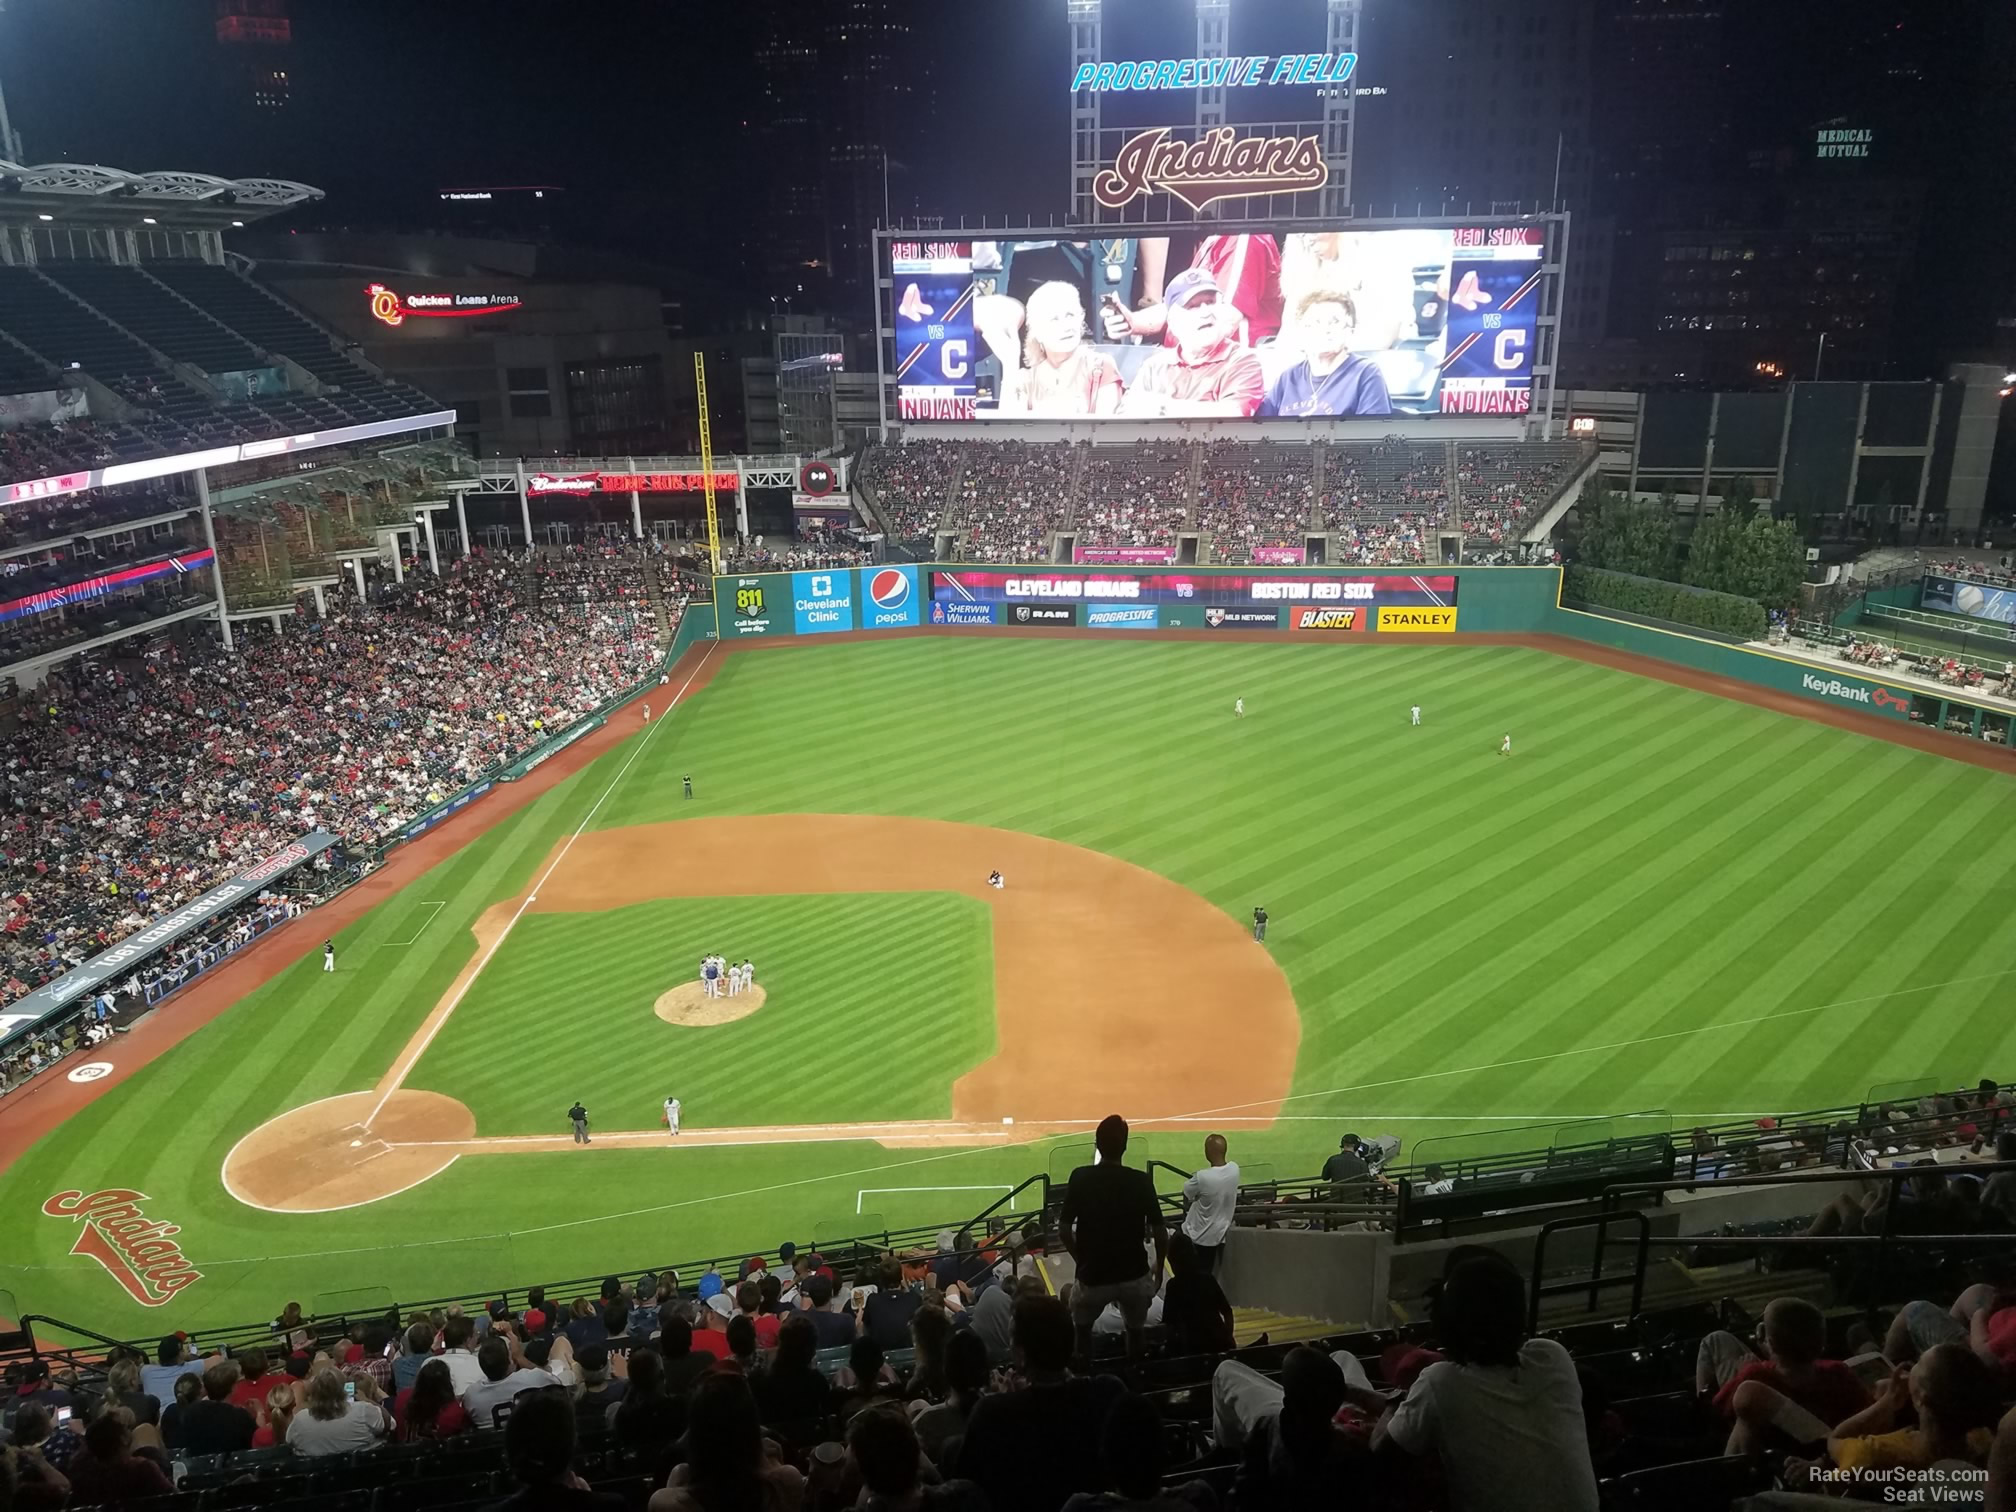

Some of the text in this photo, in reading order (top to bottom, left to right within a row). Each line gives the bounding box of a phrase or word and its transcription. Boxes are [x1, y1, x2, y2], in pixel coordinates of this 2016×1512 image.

[1070, 52, 1358, 92] PROGRESSIVE FIELD
[1817, 129, 1872, 142] MEDICAL
[1817, 144, 1868, 157] MUTUAL
[1093, 127, 1328, 211] Indians
[1452, 227, 1528, 246] RED SOX
[893, 241, 959, 260] RED SOX
[408, 294, 519, 307] Quicken Loans Arena
[1482, 313, 1502, 329] VS
[927, 324, 945, 340] VS
[1440, 390, 1530, 414] INDIANS
[530, 477, 596, 490] Budweiser
[602, 475, 646, 491] HOME
[651, 475, 682, 490] RUN
[1005, 579, 1140, 597] CLEVELAND INDIANS
[1175, 583, 1193, 597] VS
[1252, 582, 1375, 599] BOSTON RED SOX
[737, 588, 762, 608] 811
[796, 597, 849, 611] Cleveland
[808, 610, 839, 622] Clinic
[947, 602, 990, 614] SHERWIN
[1033, 610, 1069, 618] RAM
[1088, 609, 1157, 623] PROGRESSIVE
[875, 611, 908, 625] pepsi
[1299, 610, 1355, 630] BLASTER
[1383, 614, 1452, 625] STANLEY
[1802, 673, 1870, 703] KeyBank
[240, 843, 309, 882] Indians
[138, 884, 245, 944] ESTABLISHED
[41, 1188, 205, 1307] Indians
